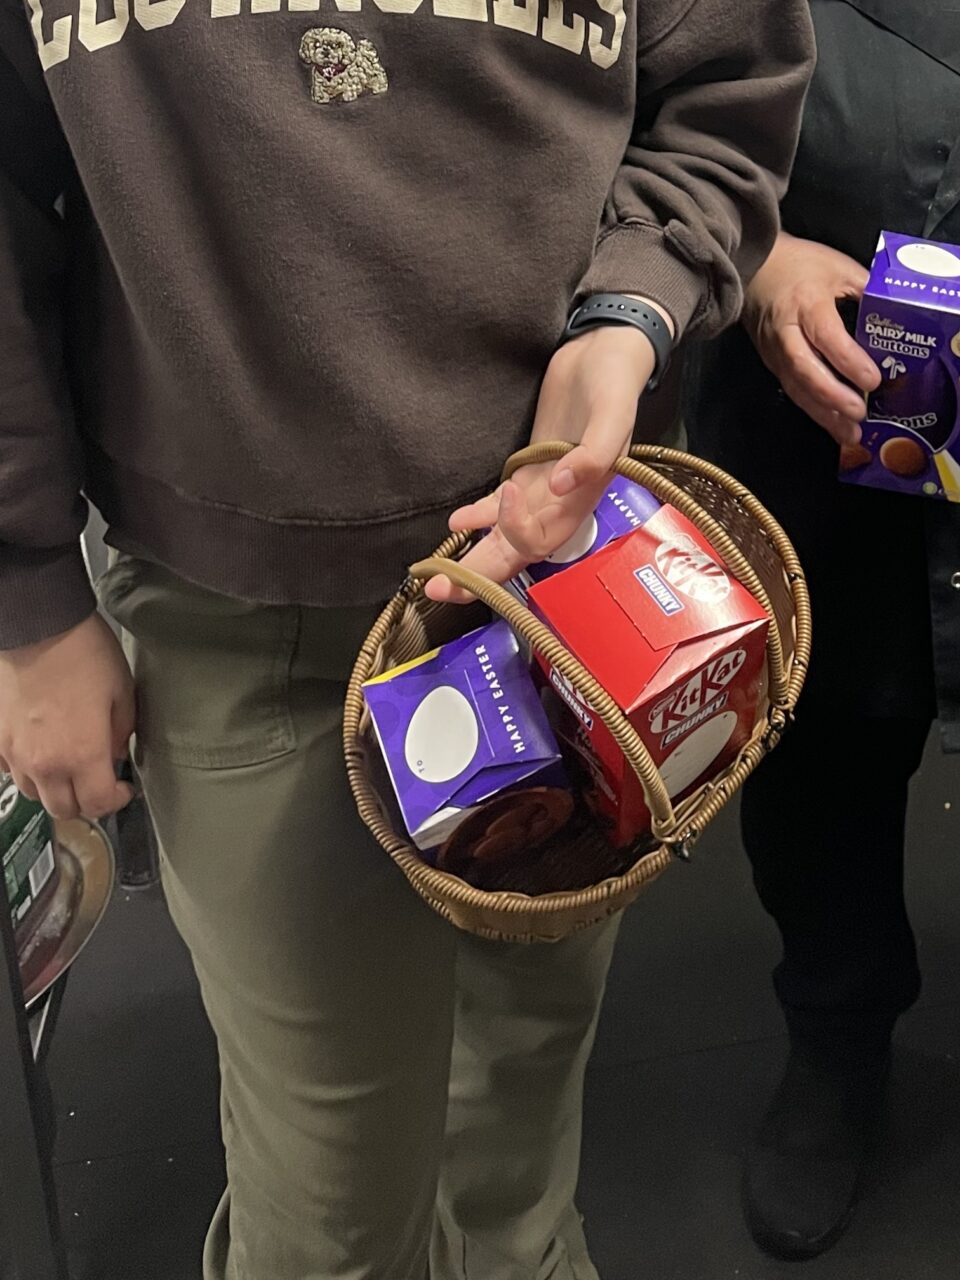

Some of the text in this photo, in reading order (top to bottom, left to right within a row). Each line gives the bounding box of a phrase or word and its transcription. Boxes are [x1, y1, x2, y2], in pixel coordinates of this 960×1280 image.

[884, 277, 926, 291] HAPPY
[865, 323, 936, 347] DAIRY MILK
[870, 335, 929, 358] buttons
[607, 491, 641, 526] HAPPY
[638, 568, 682, 613] CHUNKY
[657, 545, 730, 600] KitKat
[475, 645, 526, 753] HAPPY EASTER
[552, 672, 592, 727] CHUNKY
[659, 648, 746, 728] KitKat
[664, 696, 726, 744] CHUNKY
